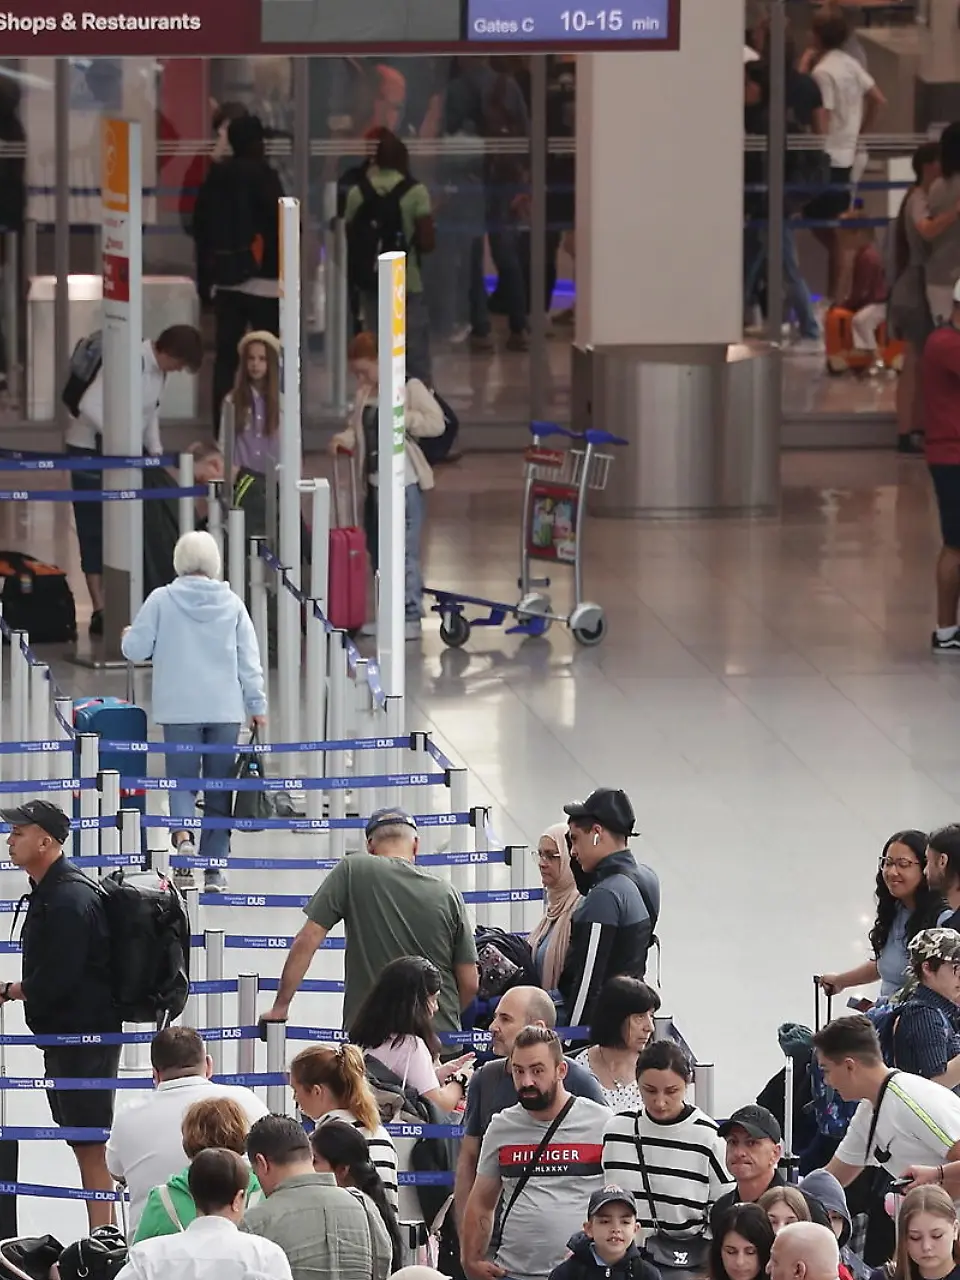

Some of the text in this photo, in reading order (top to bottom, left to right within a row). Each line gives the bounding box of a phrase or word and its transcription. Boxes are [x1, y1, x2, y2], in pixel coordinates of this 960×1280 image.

[61, 13, 76, 30] &
[82, 12, 201, 31] Restaurants
[474, 10, 659, 33] Gates C 10-15 min
[42, 742, 60, 751] DUS
[62, 780, 80, 788] DUS
[160, 780, 176, 788] DUS
[410, 776, 428, 784] DUS
[285, 780, 303, 789] DUS
[82, 820, 100, 828] DUS
[184, 818, 202, 826] DUS
[312, 820, 329, 828] DUS
[440, 816, 456, 824] DUS
[470, 853, 488, 862] DUS
[210, 858, 228, 866] DUS
[512, 892, 530, 900] DUS
[248, 896, 264, 906] DUS
[268, 938, 286, 946] DUS
[223, 1029, 240, 1037] DUS
[474, 1033, 491, 1041] DUS
[83, 1035, 100, 1043] DUS
[36, 1080, 54, 1088] DUS
[403, 1126, 421, 1135] DUS
